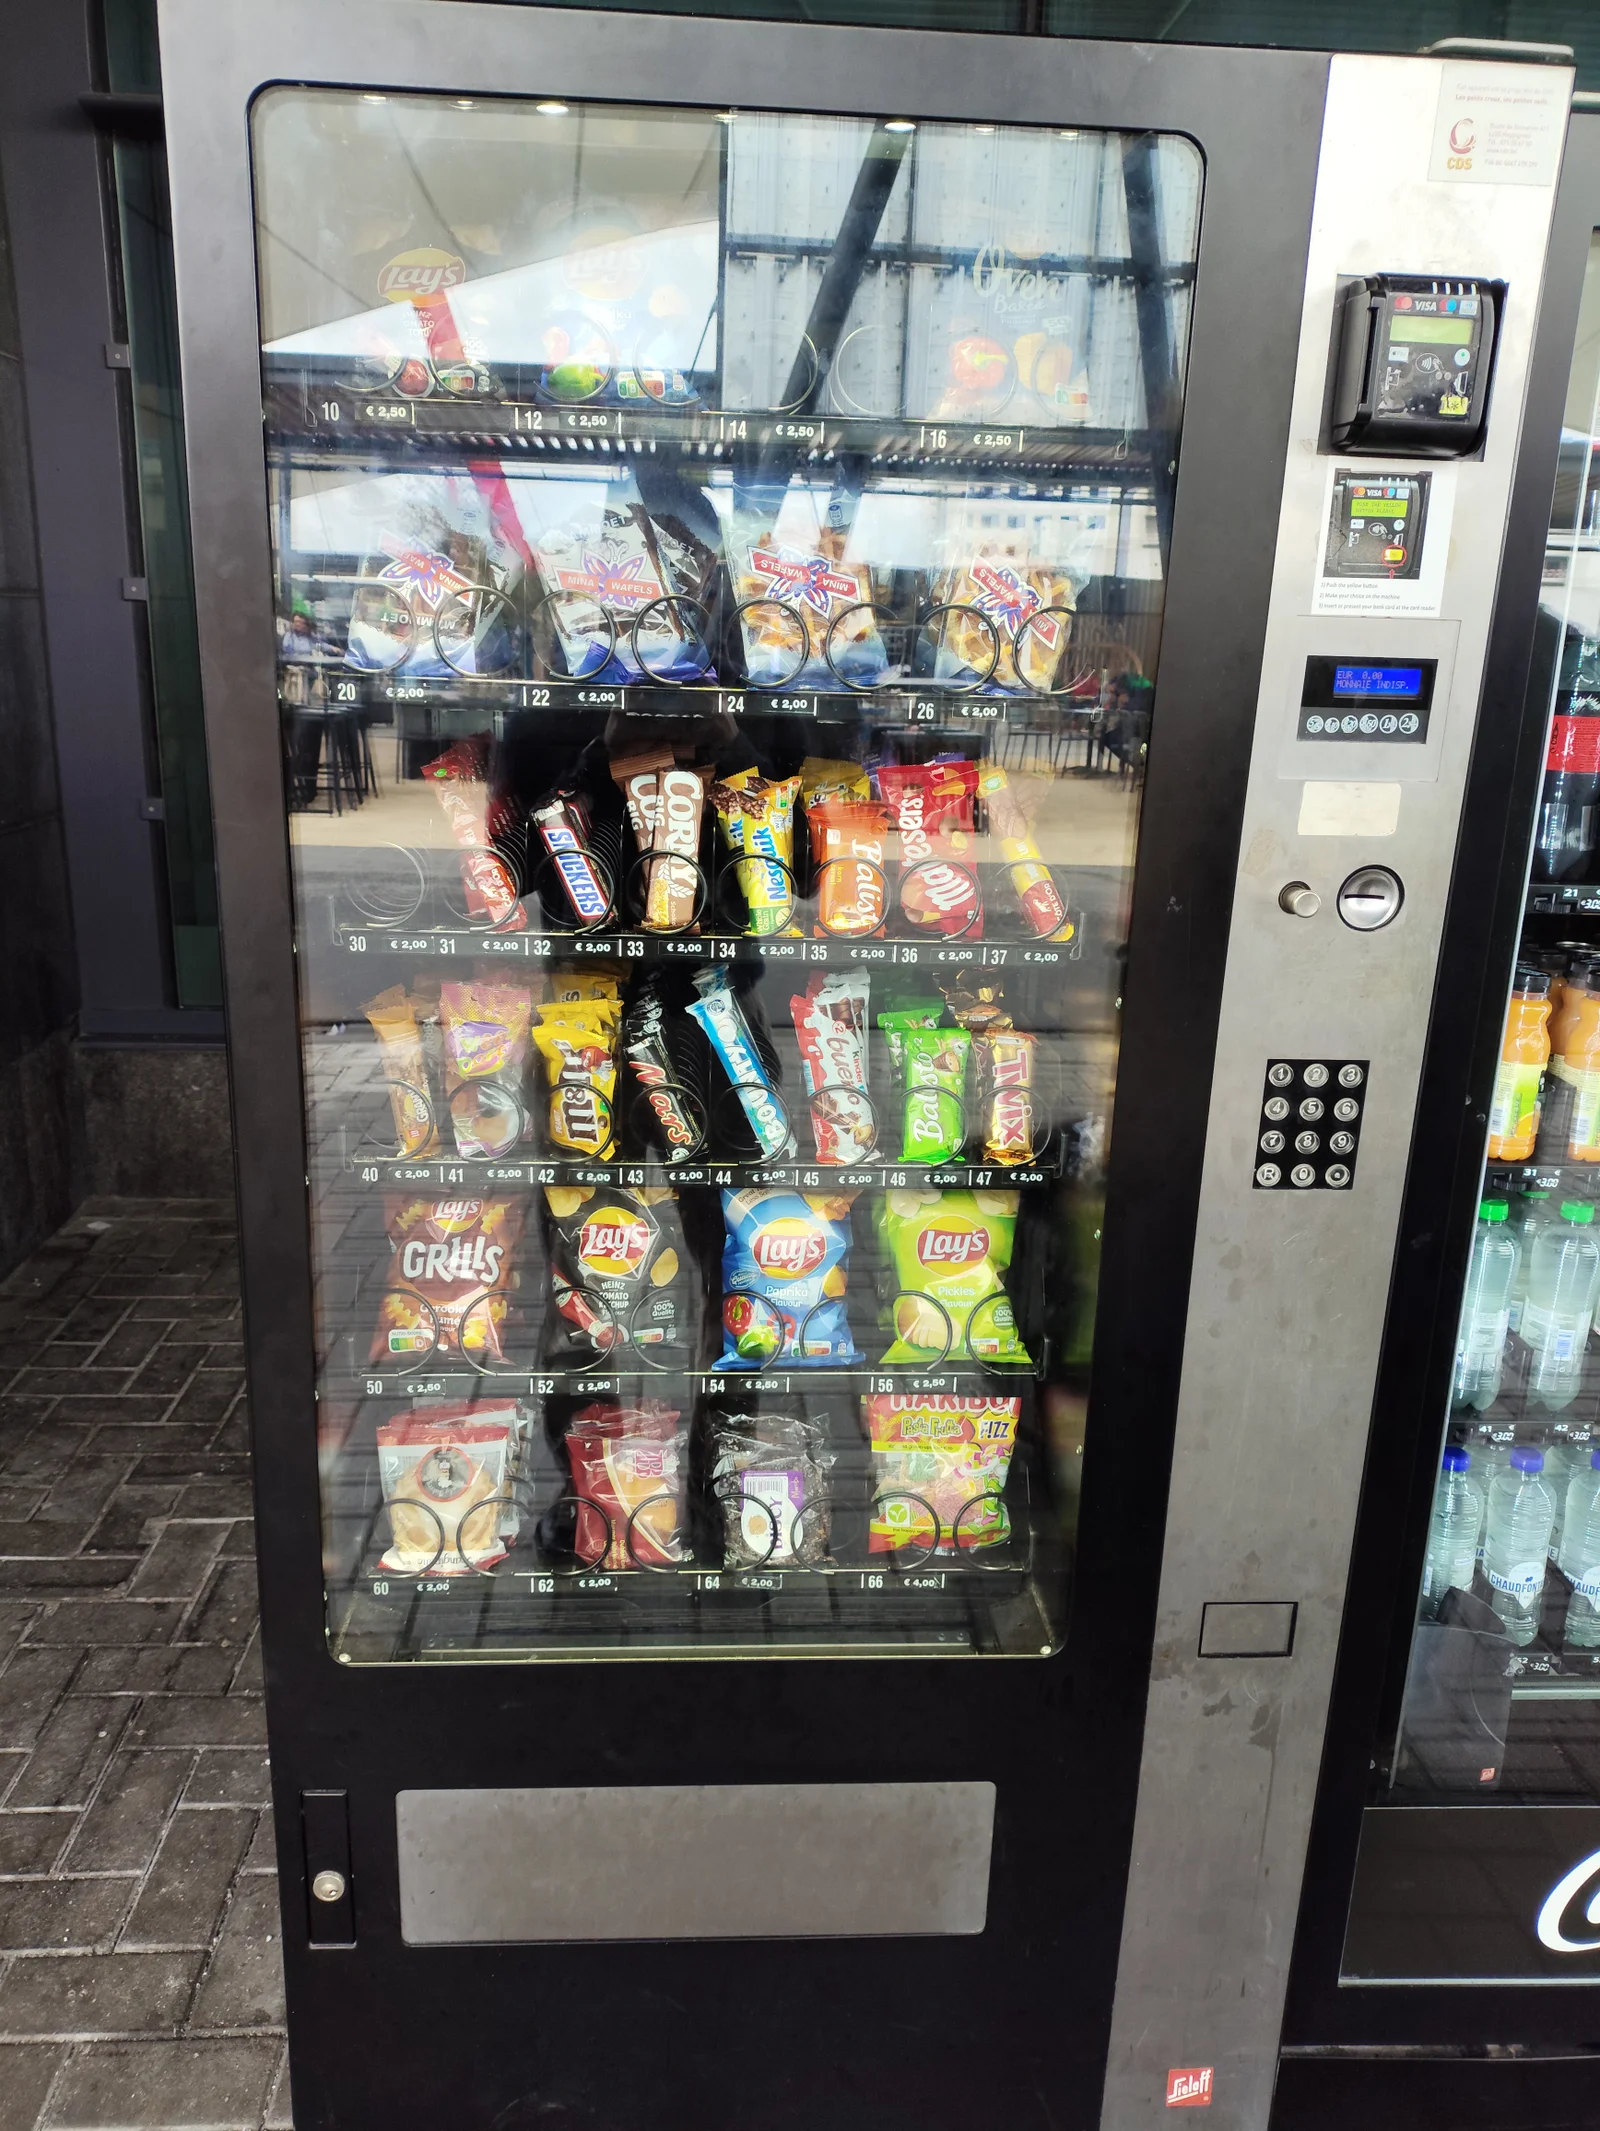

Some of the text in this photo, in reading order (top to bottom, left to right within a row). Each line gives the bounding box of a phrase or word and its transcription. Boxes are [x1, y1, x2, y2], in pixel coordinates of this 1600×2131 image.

[1446, 157, 1473, 171] CDS
[384, 261, 461, 295] Lay's
[973, 243, 1063, 302] Oven
[1415, 301, 1437, 312] VISA
[322, 402, 339, 421] 10
[378, 406, 406, 420] 2,50
[525, 411, 542, 430] 12
[580, 416, 607, 428] 2,50
[728, 420, 746, 439] 14
[787, 426, 816, 440] 2,50
[930, 430, 946, 448] 16
[984, 435, 1011, 447] 2,50
[1366, 488, 1382, 497] VISA
[438, 571, 468, 591] MINA
[760, 559, 849, 593] MINA WAFELS
[567, 576, 653, 596] MINA WAFELS
[979, 568, 1015, 603] WAFELS
[1337, 670, 1382, 680] EUR 0.00
[338, 683, 355, 700] 20
[1336, 680, 1410, 690] MONNAIE INDISP.
[397, 688, 424, 699] 2,00
[532, 689, 549, 706] 22
[589, 692, 615, 703] 2,00
[727, 696, 744, 712] 24
[782, 700, 807, 710] 2,00
[917, 703, 934, 719] 26
[972, 707, 997, 718] 2,00
[626, 800, 644, 831] BIG
[654, 795, 666, 827] BIG
[663, 770, 704, 890] CORNY
[751, 826, 788, 901] Nesquik
[548, 829, 604, 914] SNICKERS
[1564, 888, 1578, 897] 21
[350, 936, 366, 951] 30
[402, 940, 427, 950] 2,00
[440, 939, 454, 954] 31
[482, 941, 518, 951] € 2,00
[534, 940, 550, 955] 32
[576, 943, 610, 953] € 2,00
[628, 941, 644, 956] 33
[667, 943, 702, 953] € 2,00
[720, 943, 736, 958] 34
[760, 946, 794, 956] € 2,00
[811, 945, 827, 960] 35
[861, 950, 885, 959] 2,00
[902, 948, 917, 963] 36
[938, 952, 972, 961] € 2,00
[991, 950, 1007, 964] 37
[1024, 952, 1058, 962] € 2,00
[826, 1036, 860, 1106] bueno
[1312, 1068, 1320, 1080] 2
[1346, 1068, 1355, 1080] 3
[725, 1043, 787, 1147] BOUNTY
[993, 1050, 1032, 1147] Twix
[628, 1063, 694, 1144] Mars
[1272, 1102, 1282, 1114] 4
[1308, 1102, 1316, 1114] 5
[1342, 1102, 1350, 1114] 6
[555, 1110, 563, 1134] PEANUT
[1304, 1134, 1312, 1146] 8
[1338, 1134, 1346, 1147] 9
[362, 1168, 378, 1181] 40
[405, 1170, 430, 1179] 2,00
[448, 1169, 463, 1182] 41
[498, 1170, 522, 1178] 2,00
[538, 1169, 554, 1183] 42
[577, 1172, 610, 1182] € 2,00
[628, 1170, 643, 1184] 43
[670, 1172, 702, 1181] € 2,00
[716, 1171, 731, 1184] 44
[753, 1170, 787, 1182] € 2,00
[976, 1172, 992, 1185] 47
[1020, 1173, 1042, 1182] 2,00
[1263, 1168, 1274, 1180] R
[1523, 1168, 1538, 1176] 31
[804, 1172, 818, 1186] 45
[839, 1176, 872, 1184] € 2,00
[890, 1172, 906, 1186] 46
[934, 1175, 957, 1184] 2,00
[436, 1200, 480, 1221] Lay's
[583, 1223, 645, 1261] Lay's
[922, 1230, 985, 1264] Lay's
[760, 1233, 822, 1272] Lay's
[402, 1235, 504, 1284] GRILLS
[600, 1280, 626, 1290] HEINZ
[765, 1285, 808, 1298] Paprika
[937, 1286, 975, 1296] Pickles
[598, 1292, 629, 1300] TOMATO
[652, 1304, 674, 1312] 100%
[770, 1299, 803, 1308] Flavour
[940, 1300, 974, 1308] Flavour
[652, 1310, 675, 1318] Quality
[367, 1381, 382, 1394] 50
[407, 1383, 440, 1393] € 2,50
[538, 1380, 553, 1394] 52
[588, 1381, 610, 1392] 2,50
[710, 1379, 725, 1392] 54
[756, 1379, 778, 1390] 2,50
[878, 1379, 893, 1392] 56
[913, 1379, 945, 1388] € 2,50
[890, 1395, 1011, 1412] HARIBO
[902, 1417, 963, 1437] Pasta Frutta
[1480, 1424, 1492, 1432] 41
[374, 1582, 388, 1595] 60
[427, 1583, 449, 1592] 2,00
[538, 1579, 554, 1592] 62
[589, 1578, 611, 1588] 2,00
[705, 1576, 720, 1589] 64
[751, 1579, 772, 1588] 2,00
[868, 1576, 883, 1588] 66
[913, 1579, 936, 1588] 4,00
[1168, 2069, 1212, 2102] Sielaff
